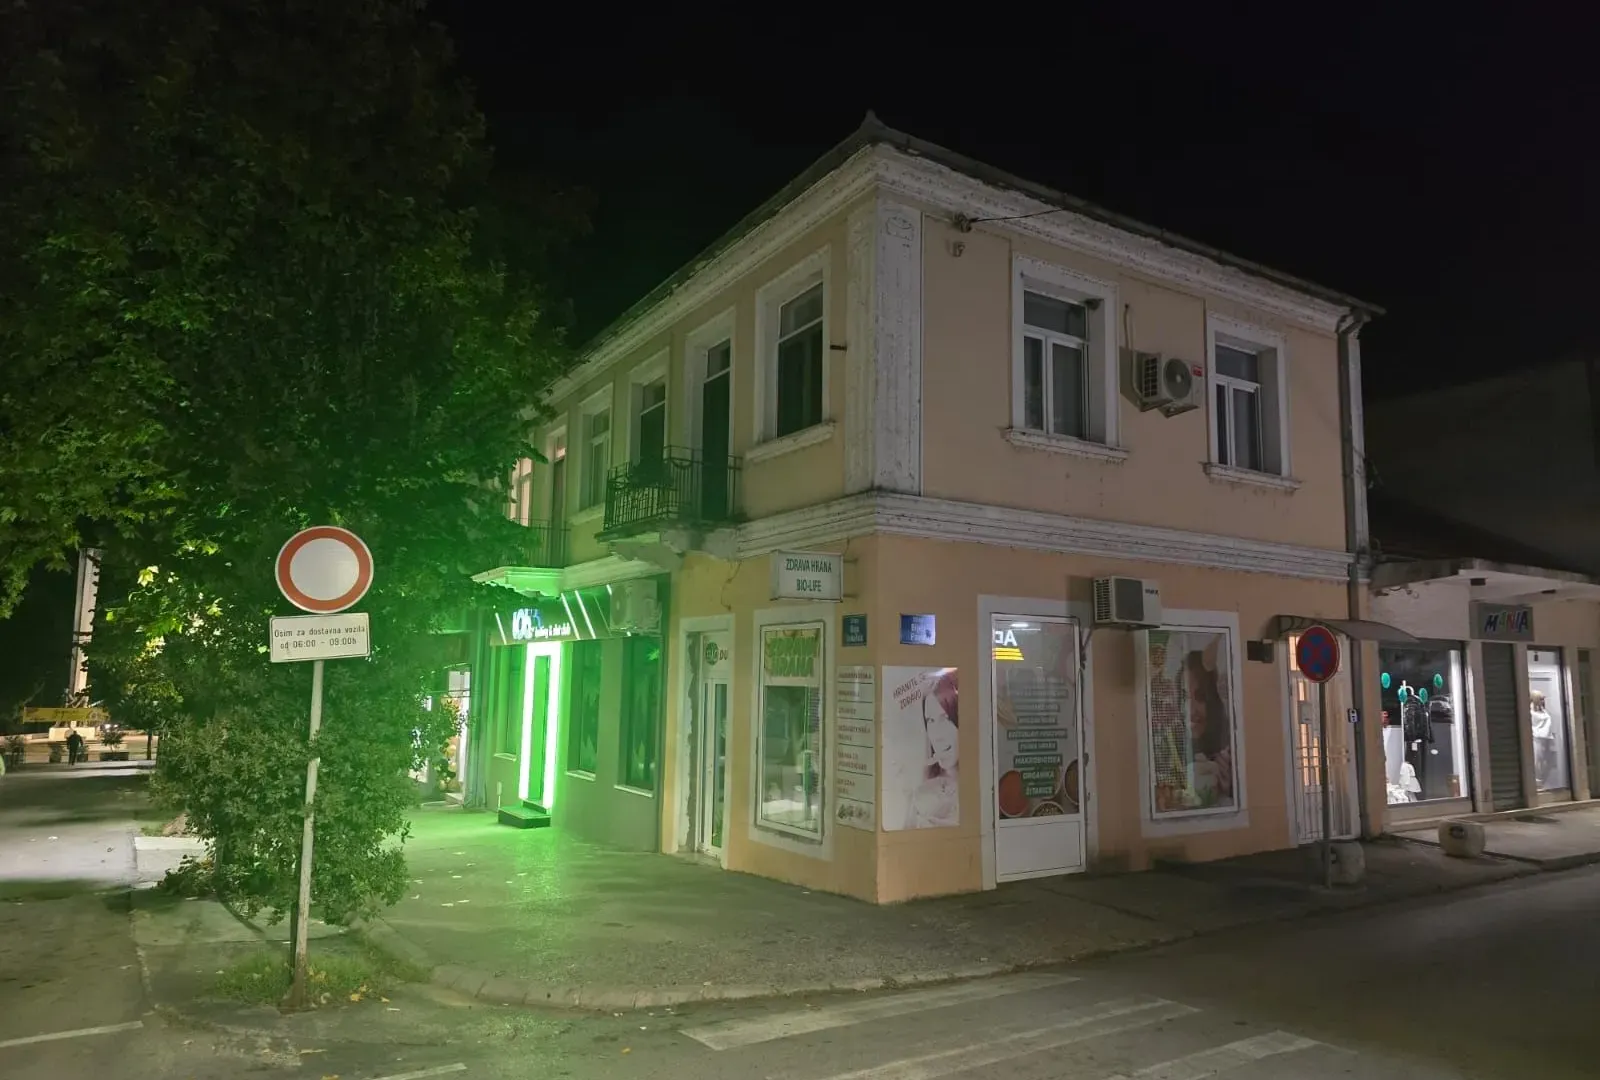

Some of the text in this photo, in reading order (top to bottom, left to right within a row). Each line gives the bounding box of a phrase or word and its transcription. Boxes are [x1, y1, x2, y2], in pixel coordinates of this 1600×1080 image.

[785, 558, 832, 573] ZDRAVA HRANA
[796, 579, 822, 592] BIO-LIFE
[1484, 610, 1529, 633] MANIA
[274, 629, 293, 637] Osim
[309, 627, 341, 636] dostavna
[345, 625, 365, 634] vozila
[280, 642, 289, 650] od
[293, 639, 316, 649] 06:00
[893, 677, 918, 699] HRANITE
[900, 689, 922, 710] ZDRAVO
